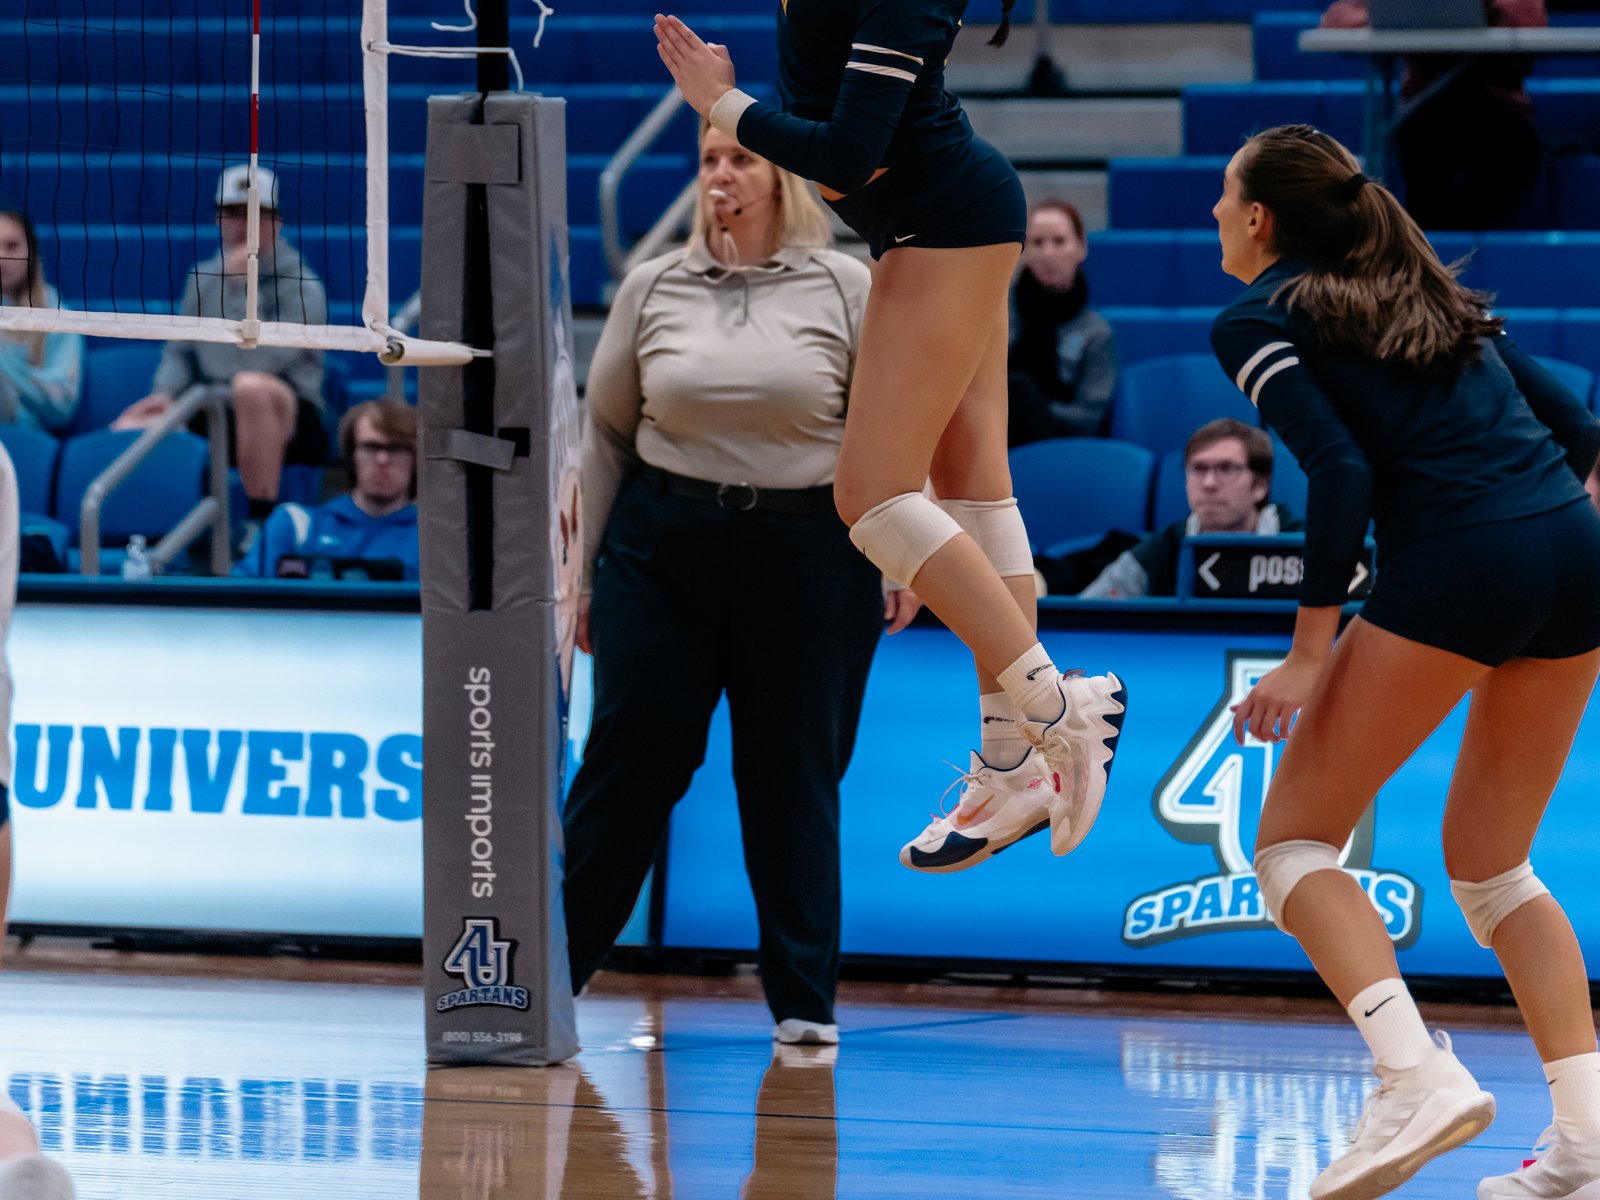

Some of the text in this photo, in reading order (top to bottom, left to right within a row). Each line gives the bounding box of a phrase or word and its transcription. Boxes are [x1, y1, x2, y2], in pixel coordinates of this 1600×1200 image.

[1248, 554, 1304, 593] pos
[13, 723, 422, 822] UNIVERS
[463, 667, 497, 898] sports imports
[1124, 871, 1414, 940] SPARS
[436, 985, 528, 1011] SPARTANS
[442, 1031, 470, 1044] (800)
